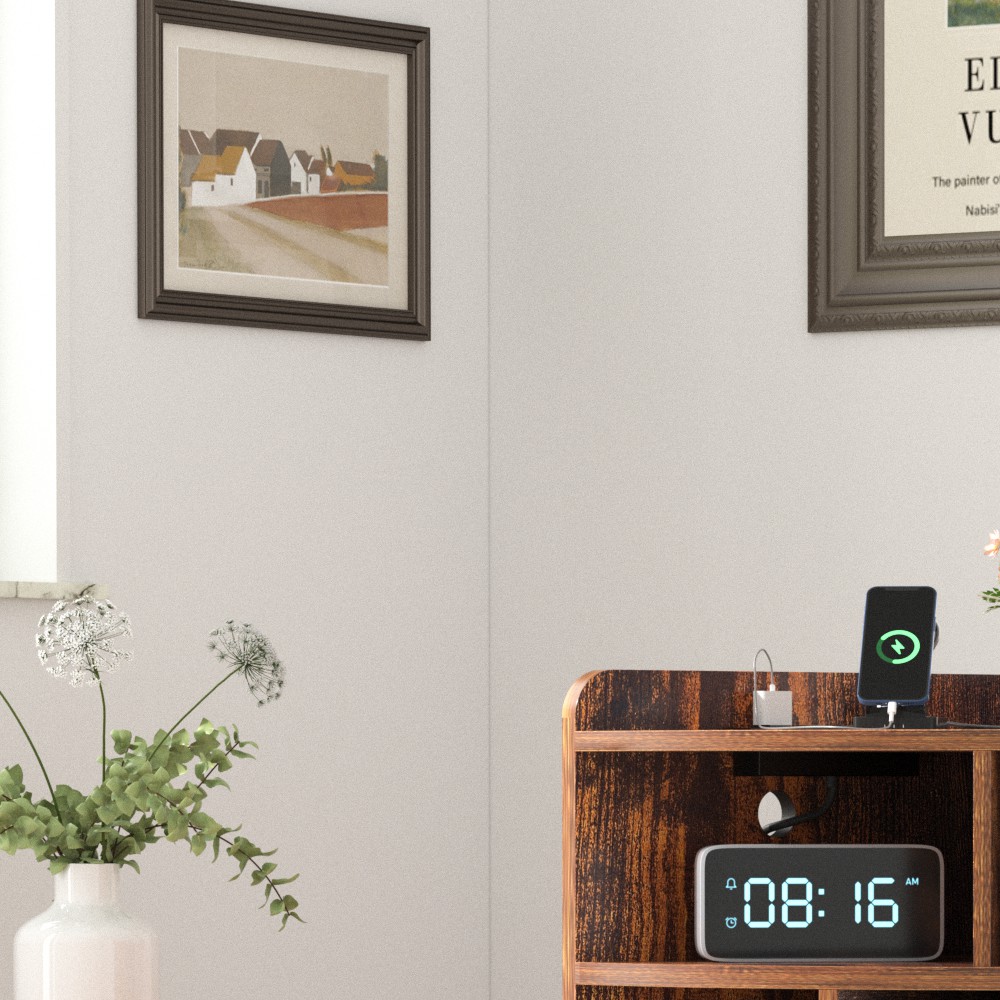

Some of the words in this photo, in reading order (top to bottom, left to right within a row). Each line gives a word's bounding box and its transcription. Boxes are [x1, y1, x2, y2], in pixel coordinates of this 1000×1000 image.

[932, 176, 951, 188] The
[954, 176, 989, 188] painter
[905, 877, 919, 885] AM
